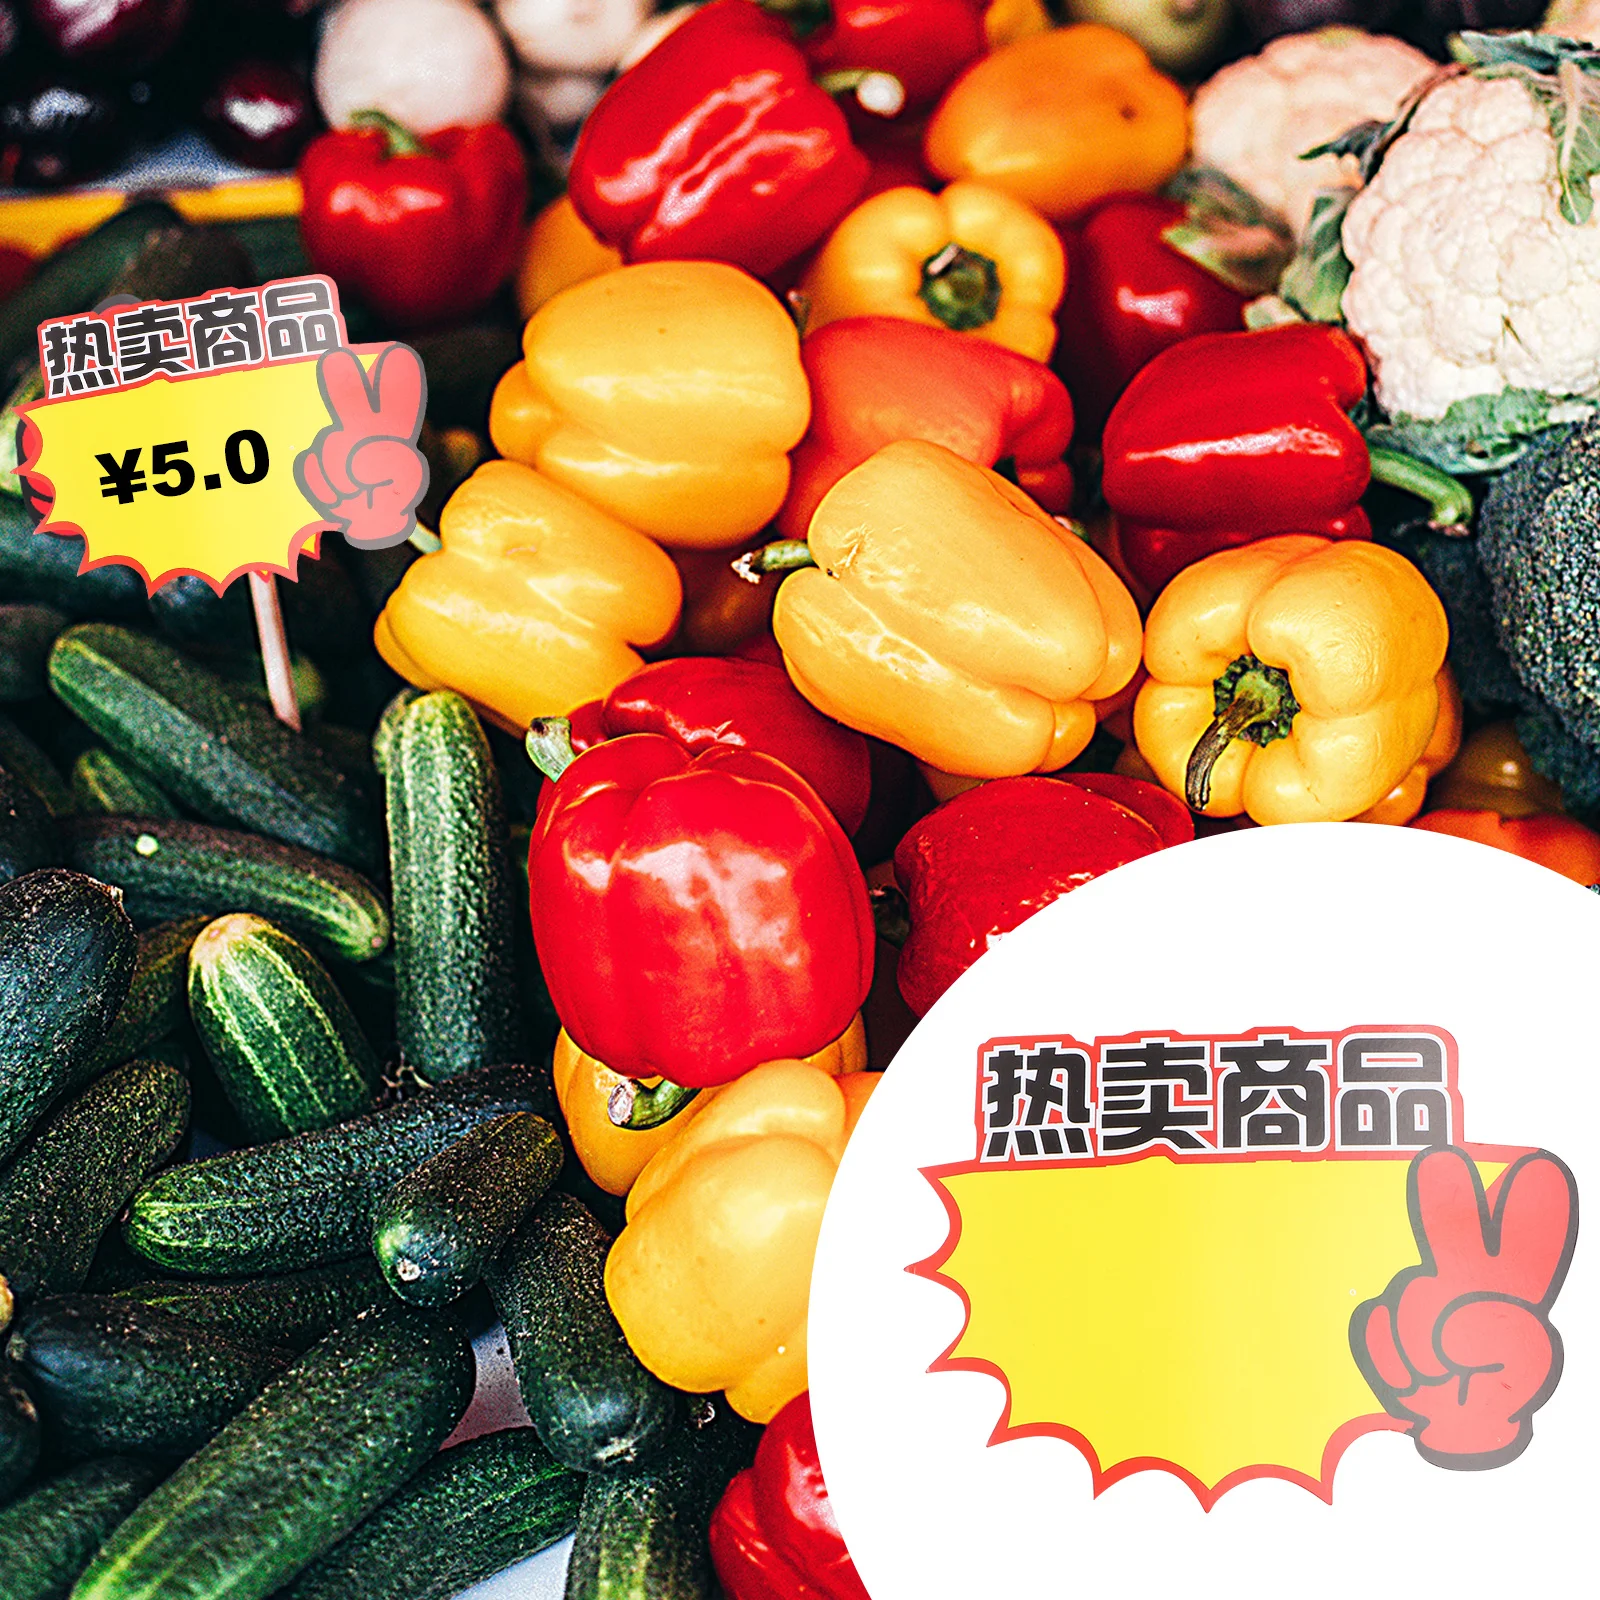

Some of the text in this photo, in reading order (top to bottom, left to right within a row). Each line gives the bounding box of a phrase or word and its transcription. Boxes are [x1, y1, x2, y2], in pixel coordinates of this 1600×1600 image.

[42, 279, 342, 399] 热卖商品
[95, 429, 270, 504] ¥5.0
[981, 1033, 1453, 1163] 热卖商品
